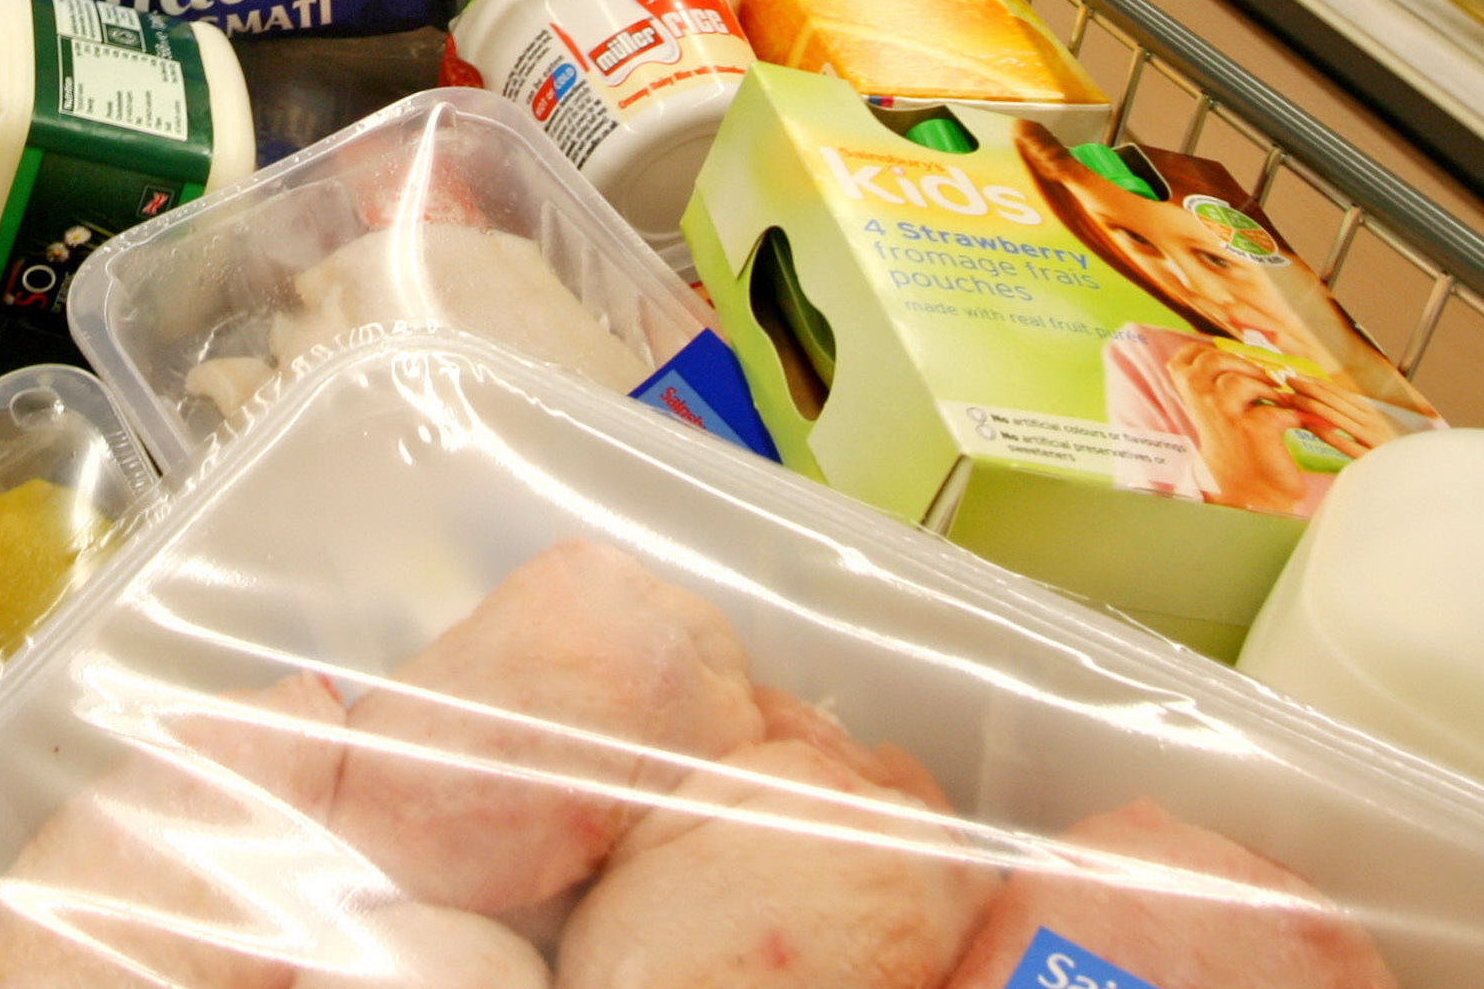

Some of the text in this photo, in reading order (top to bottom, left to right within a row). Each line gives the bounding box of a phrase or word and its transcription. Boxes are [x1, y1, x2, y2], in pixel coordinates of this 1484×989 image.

[595, 25, 657, 72] müller
[818, 145, 1043, 226] kids
[863, 218, 1091, 270] 4 Strawberry
[875, 240, 1102, 291] fromage frais
[889, 268, 1034, 302] pouches
[905, 300, 959, 317] made
[966, 305, 1006, 323] with
[1009, 310, 1046, 328] real
[1048, 316, 1089, 334] fruit
